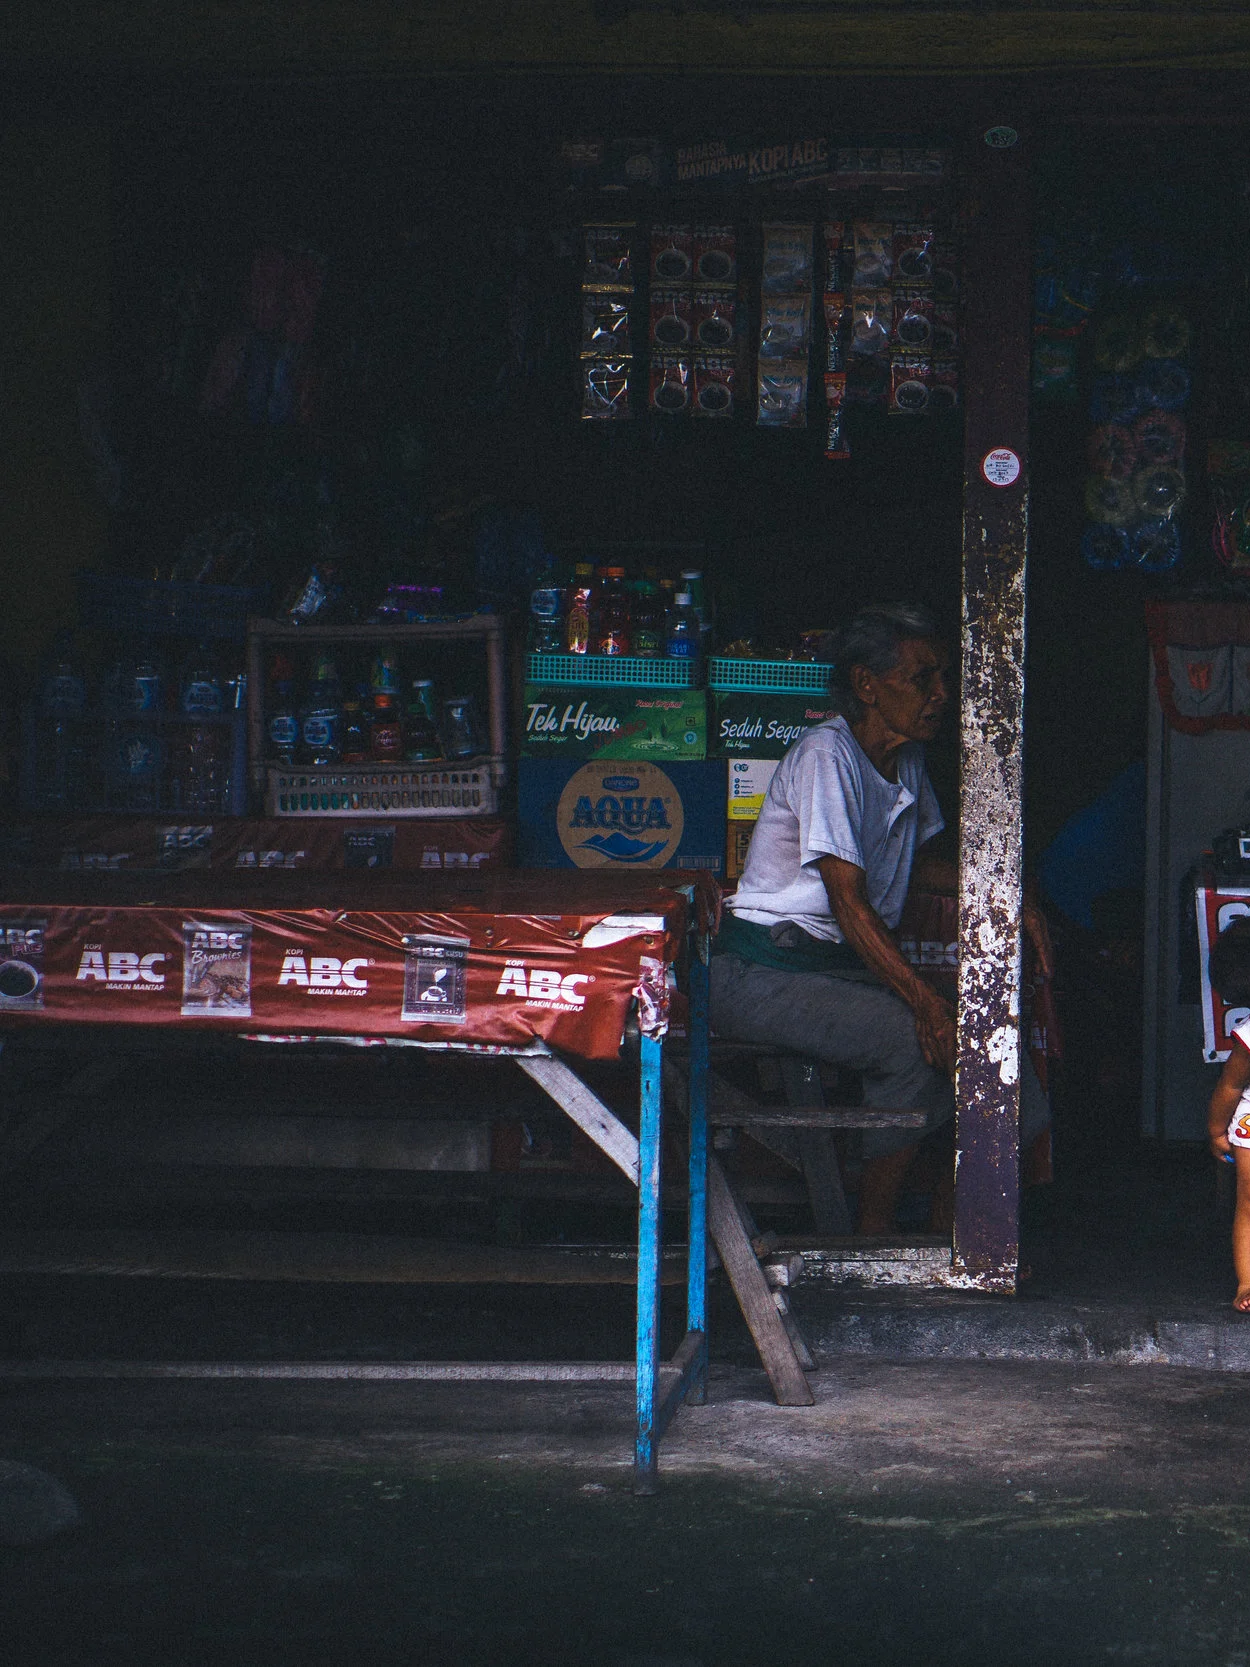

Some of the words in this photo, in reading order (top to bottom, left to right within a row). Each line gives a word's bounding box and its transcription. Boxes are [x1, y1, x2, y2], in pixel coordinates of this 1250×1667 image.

[748, 144, 788, 175] KOPI
[791, 137, 829, 167] ABC
[526, 704, 558, 732] Teh
[560, 701, 620, 742] Hijau
[719, 717, 763, 738] Seduh
[765, 720, 808, 746] Segar
[569, 795, 673, 835] AQUA
[192, 932, 243, 950] ABC
[76, 951, 166, 983] ABC
[191, 950, 243, 965] Brownies
[278, 956, 369, 988] ABC
[106, 983, 131, 991] MAKIN
[132, 983, 165, 992] MANTAP
[307, 988, 334, 996] MAKIN
[496, 967, 589, 1005] ABC
[526, 999, 555, 1009] MAKIN
[555, 1002, 584, 1012] MANTAP
